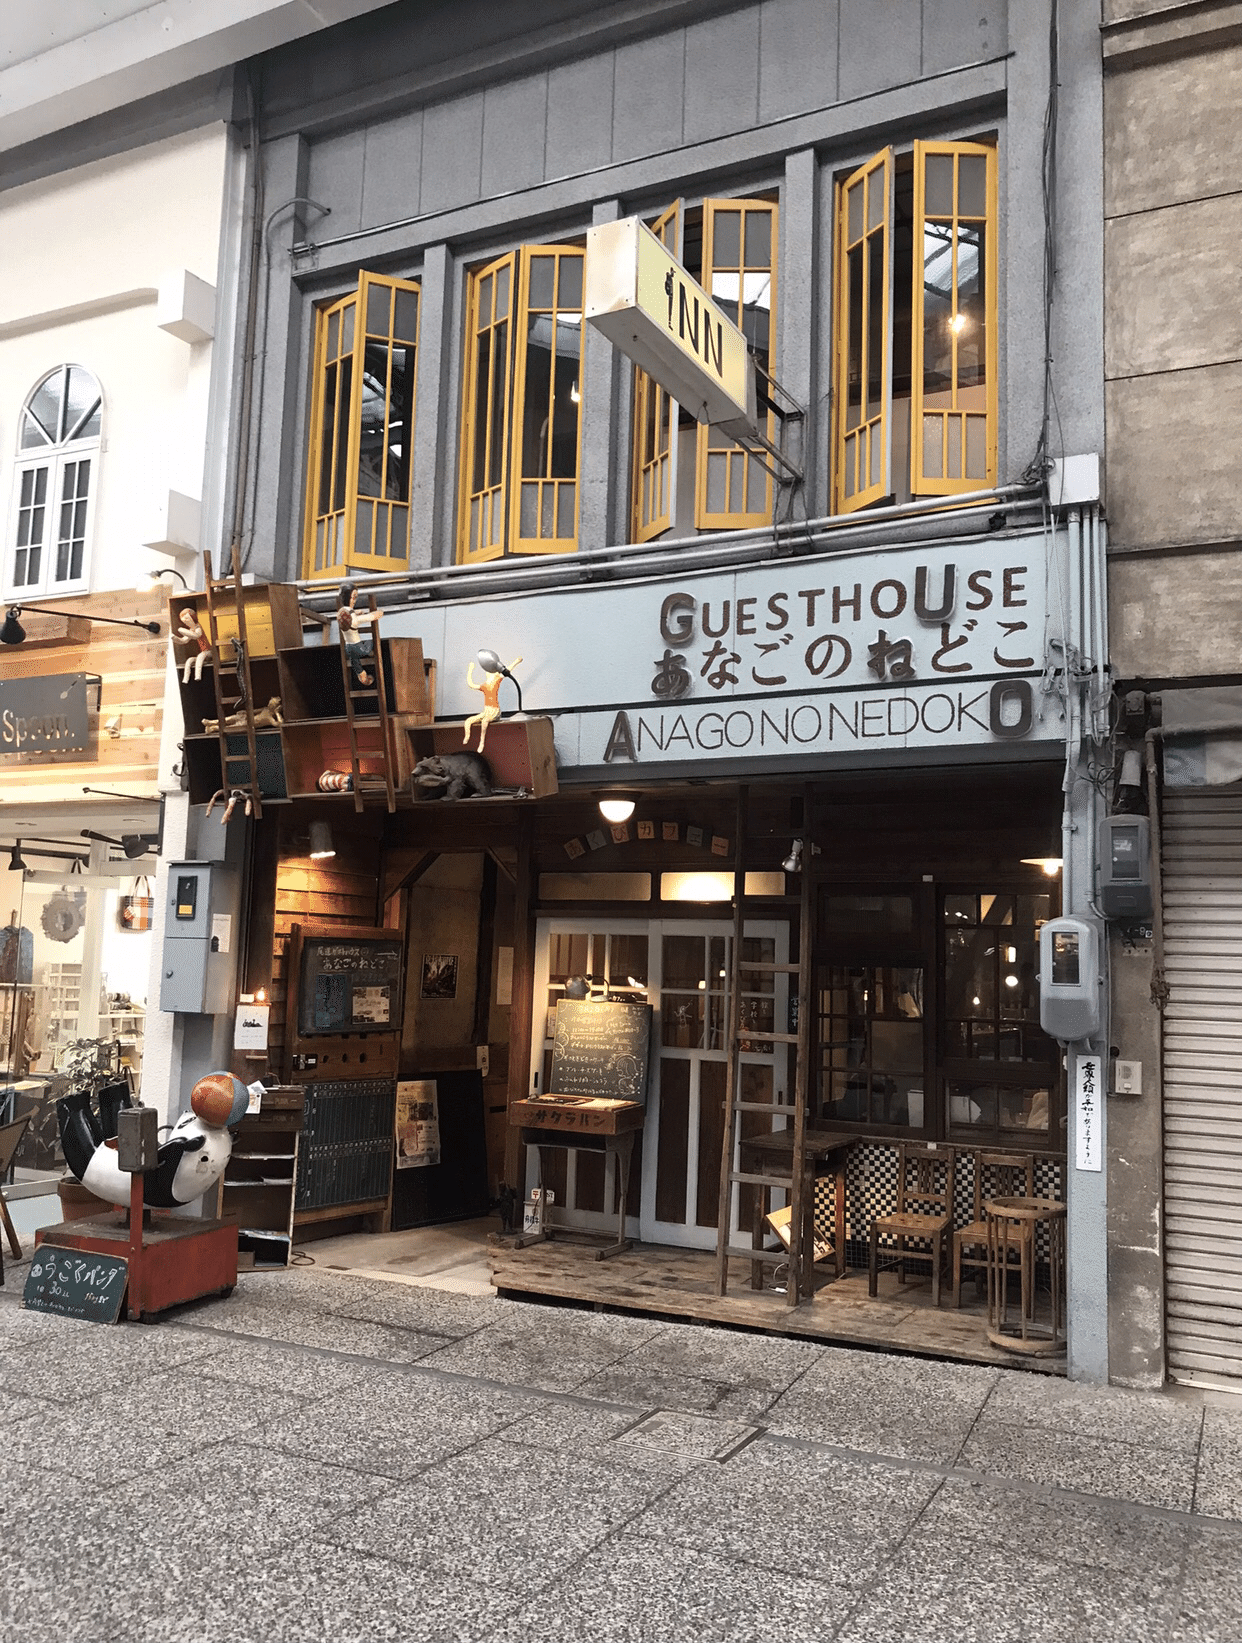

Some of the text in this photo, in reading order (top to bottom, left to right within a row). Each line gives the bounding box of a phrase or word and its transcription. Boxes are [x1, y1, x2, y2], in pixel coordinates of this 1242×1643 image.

[659, 563, 1029, 643] GUESTHOUSE
[651, 619, 1034, 699] あなごのねどこ
[323, 957, 385, 970] あなごのねどこ
[1080, 1062, 1096, 1165] 世界人類が平和でありますように
